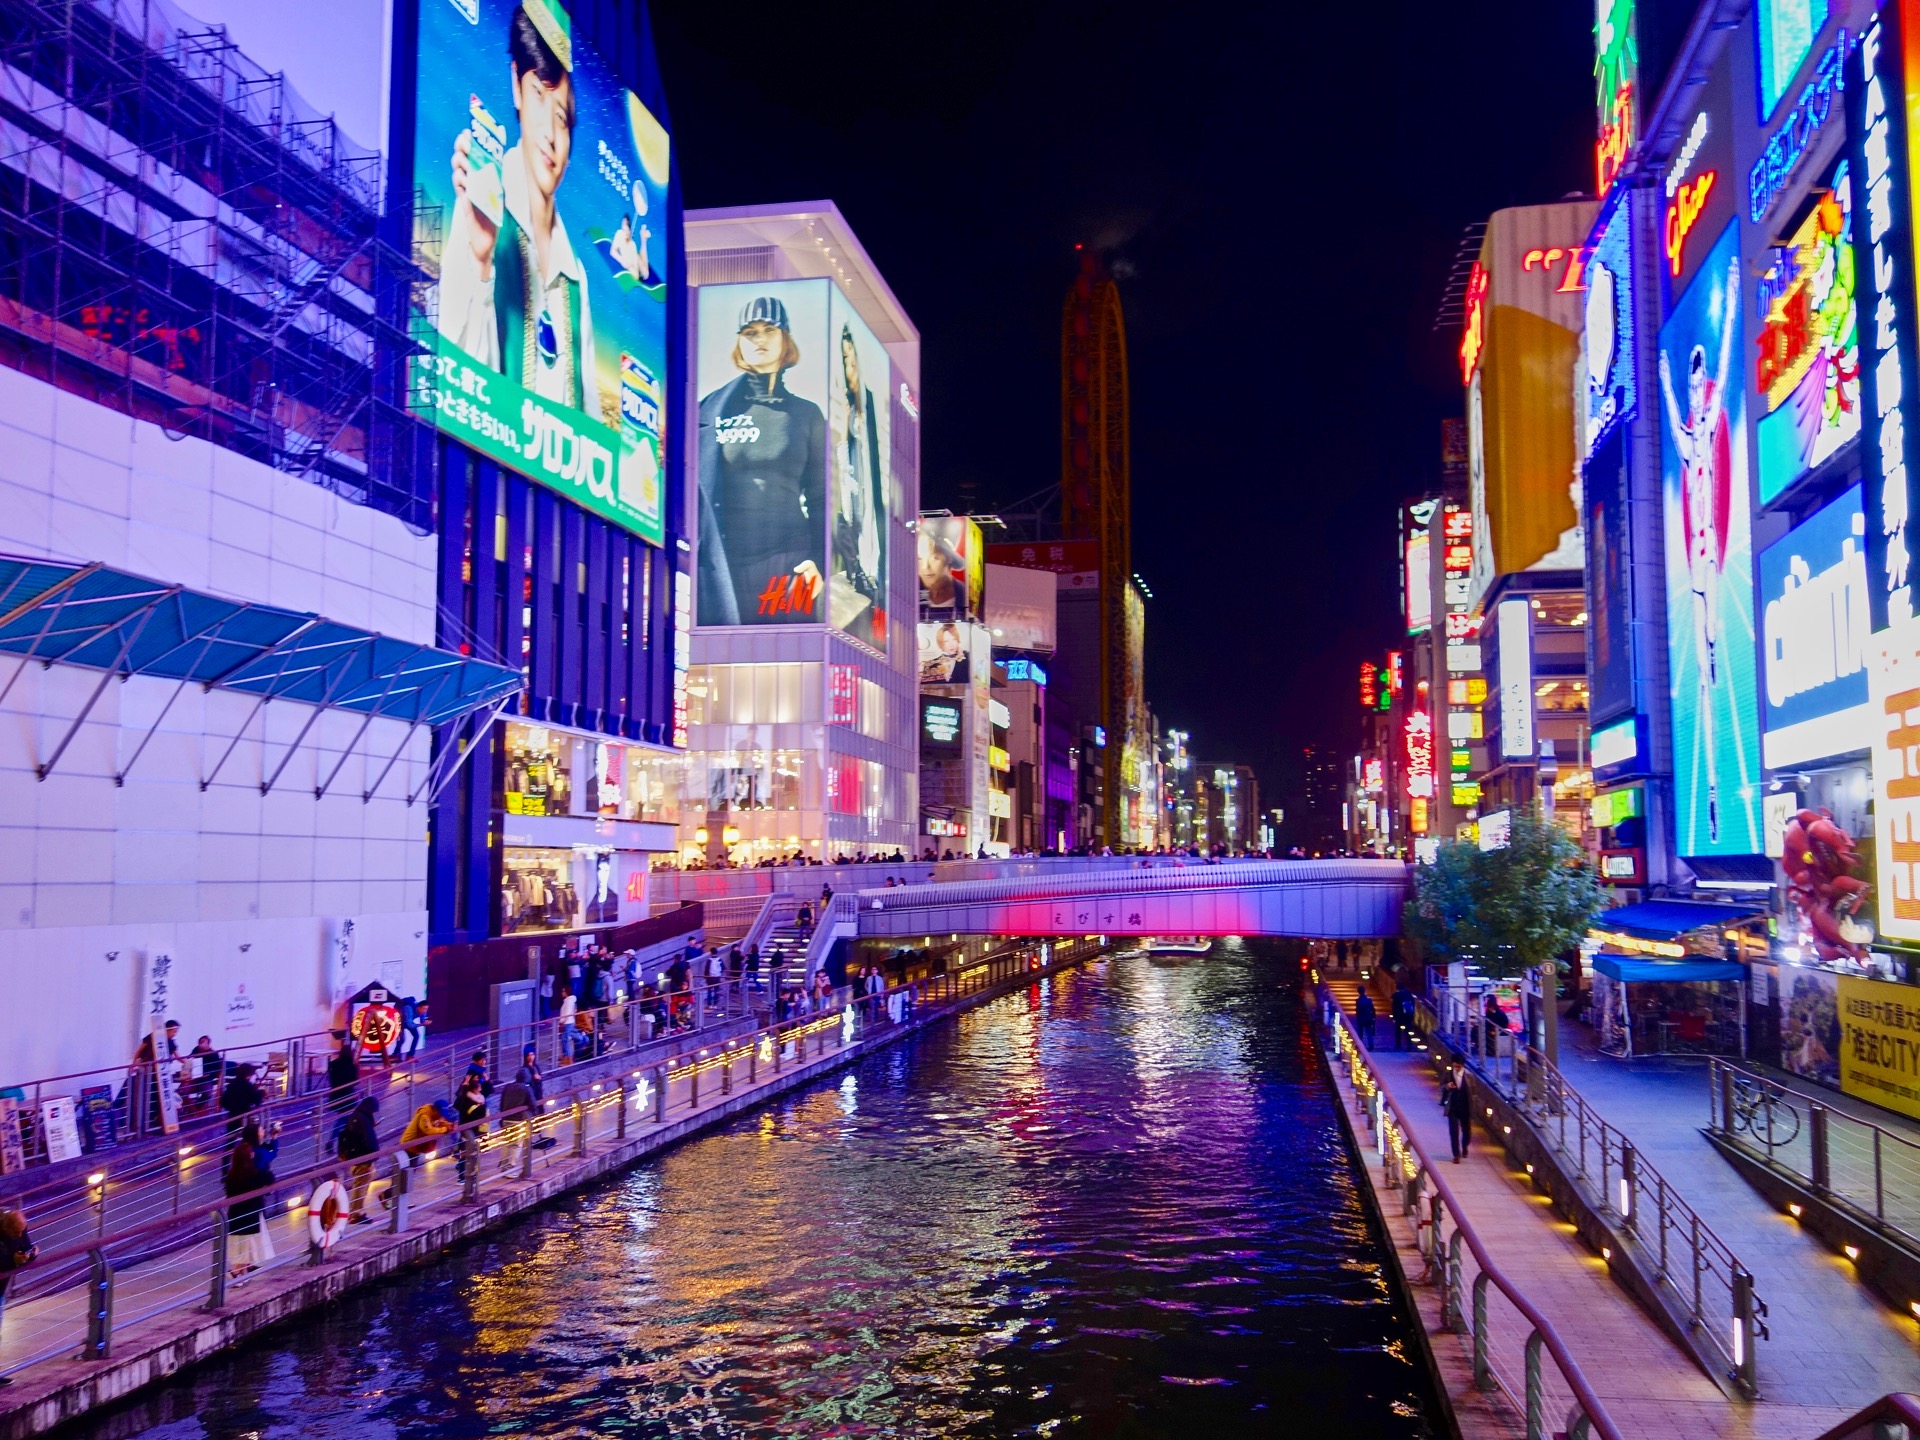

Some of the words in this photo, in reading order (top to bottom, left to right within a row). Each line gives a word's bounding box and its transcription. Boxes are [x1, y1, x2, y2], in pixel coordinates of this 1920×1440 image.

[715, 415, 754, 427] トップス
[715, 428, 760, 443] ¥999
[522, 398, 616, 507] サロンパス
[758, 574, 818, 615] H&M
[1054, 912, 1141, 926] えびす橋
